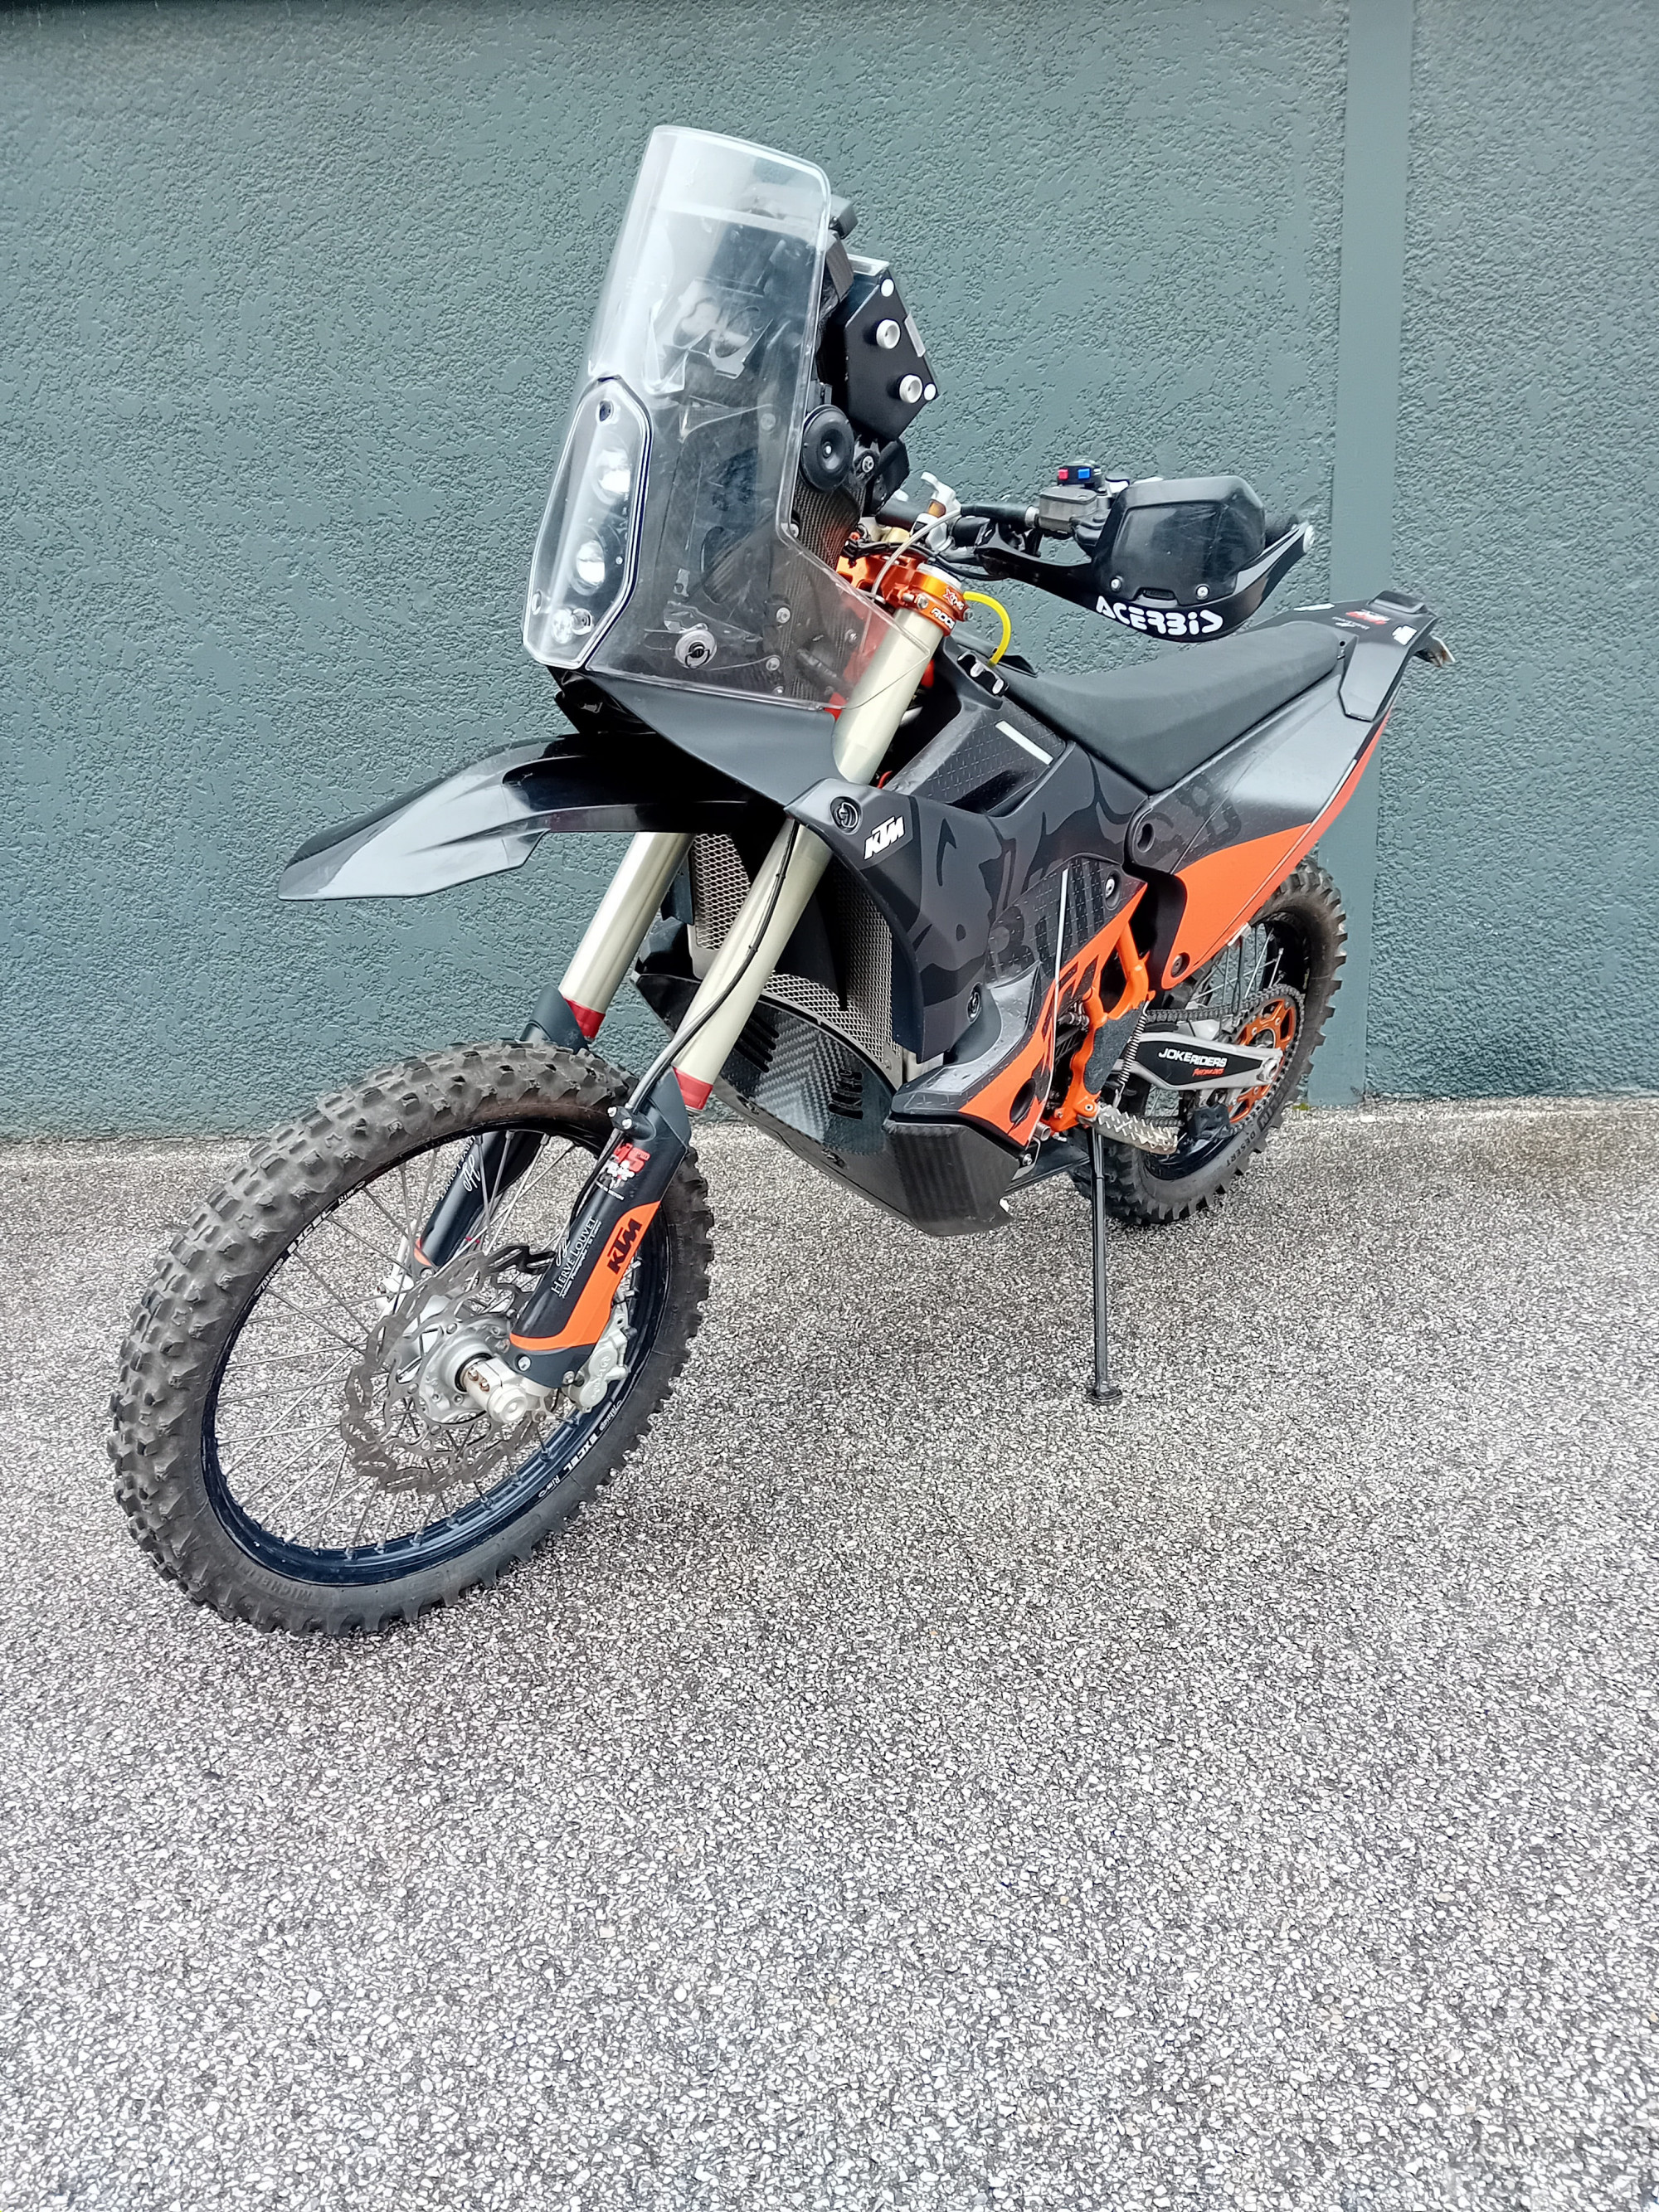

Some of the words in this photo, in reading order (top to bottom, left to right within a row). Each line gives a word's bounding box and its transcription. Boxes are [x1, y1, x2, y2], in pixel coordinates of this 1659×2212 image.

[864, 816, 905, 860] KTM
[1224, 1130, 1257, 1167] DESERT
[286, 1209, 332, 1254] EXCEL
[569, 1215, 596, 1257] LOUVET
[607, 1218, 643, 1275] KTM
[562, 1432, 597, 1472] EXCEL
